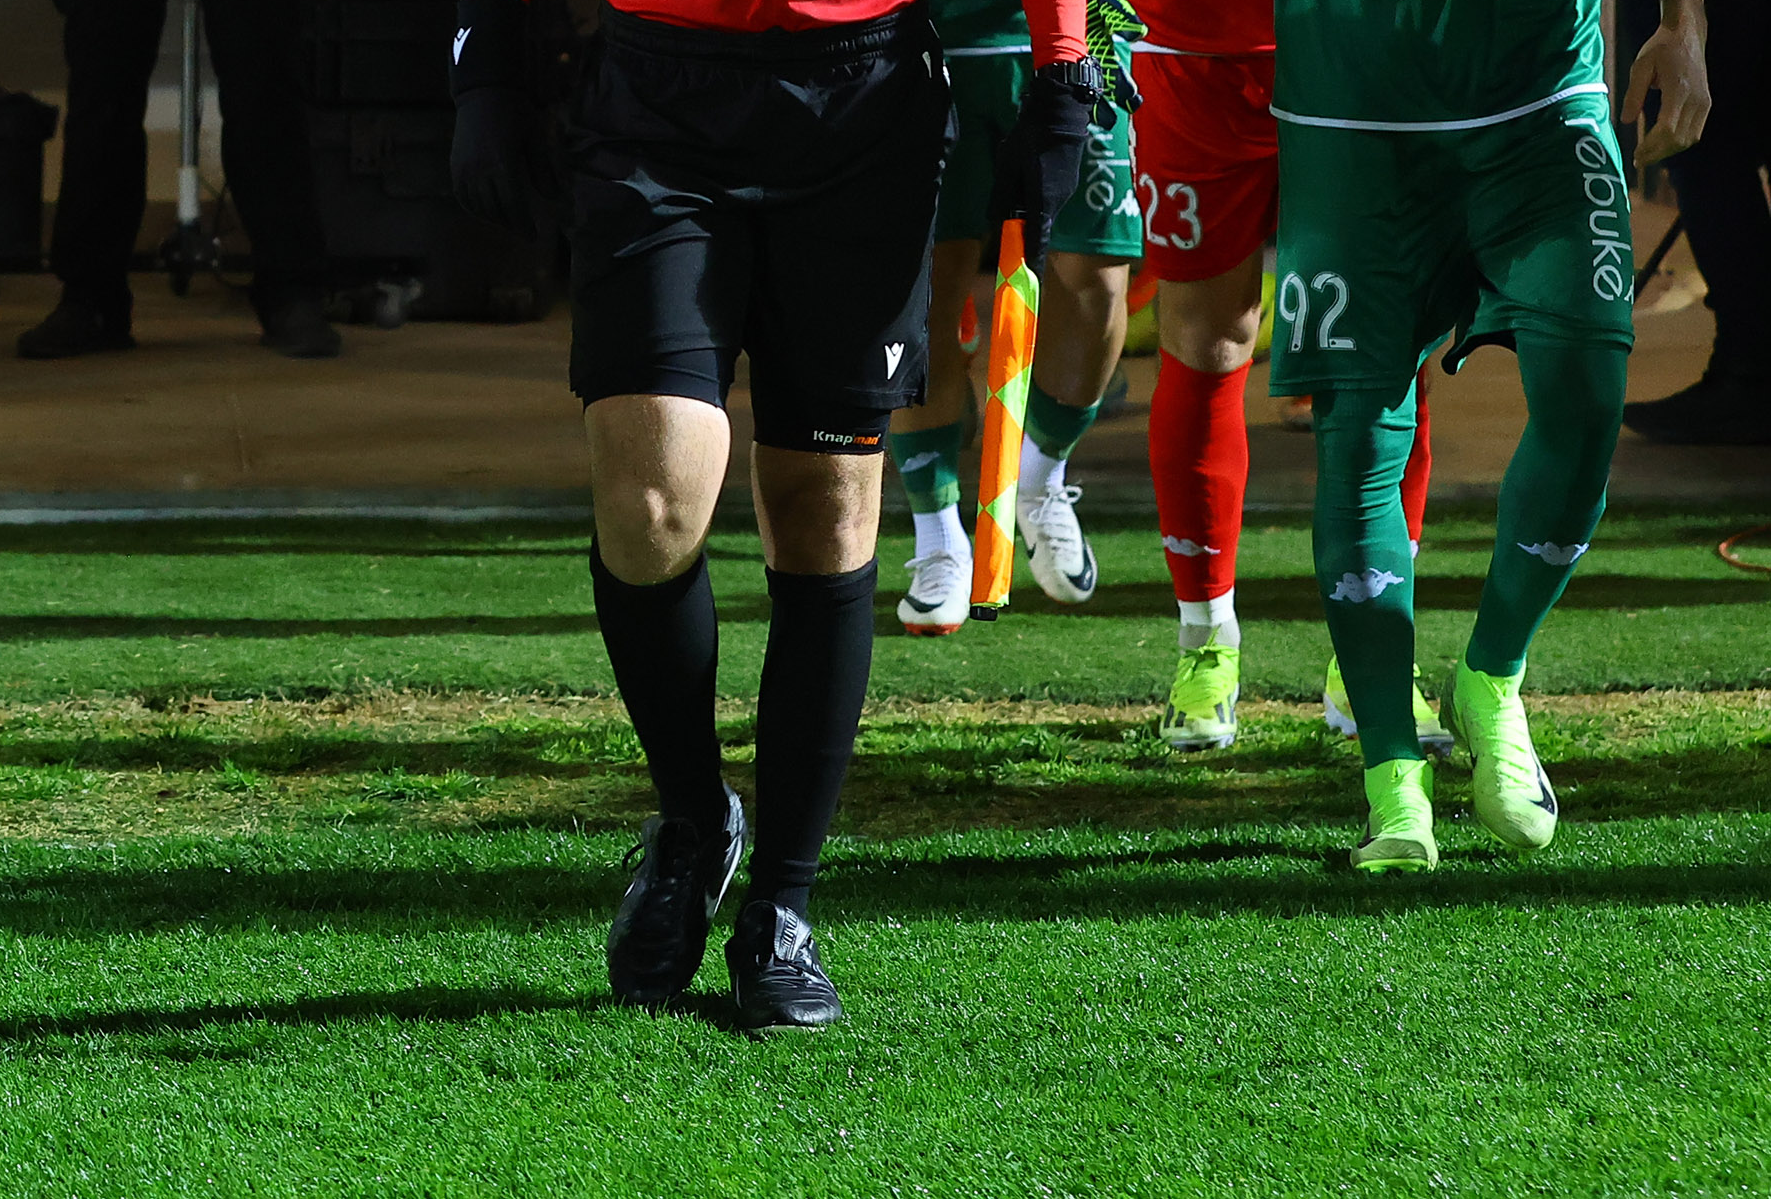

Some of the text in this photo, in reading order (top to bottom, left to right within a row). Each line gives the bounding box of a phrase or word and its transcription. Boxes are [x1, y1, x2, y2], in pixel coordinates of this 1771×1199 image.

[1139, 172, 1202, 250] 23
[1560, 116, 1632, 302] rebuke
[1279, 270, 1357, 354] 92
